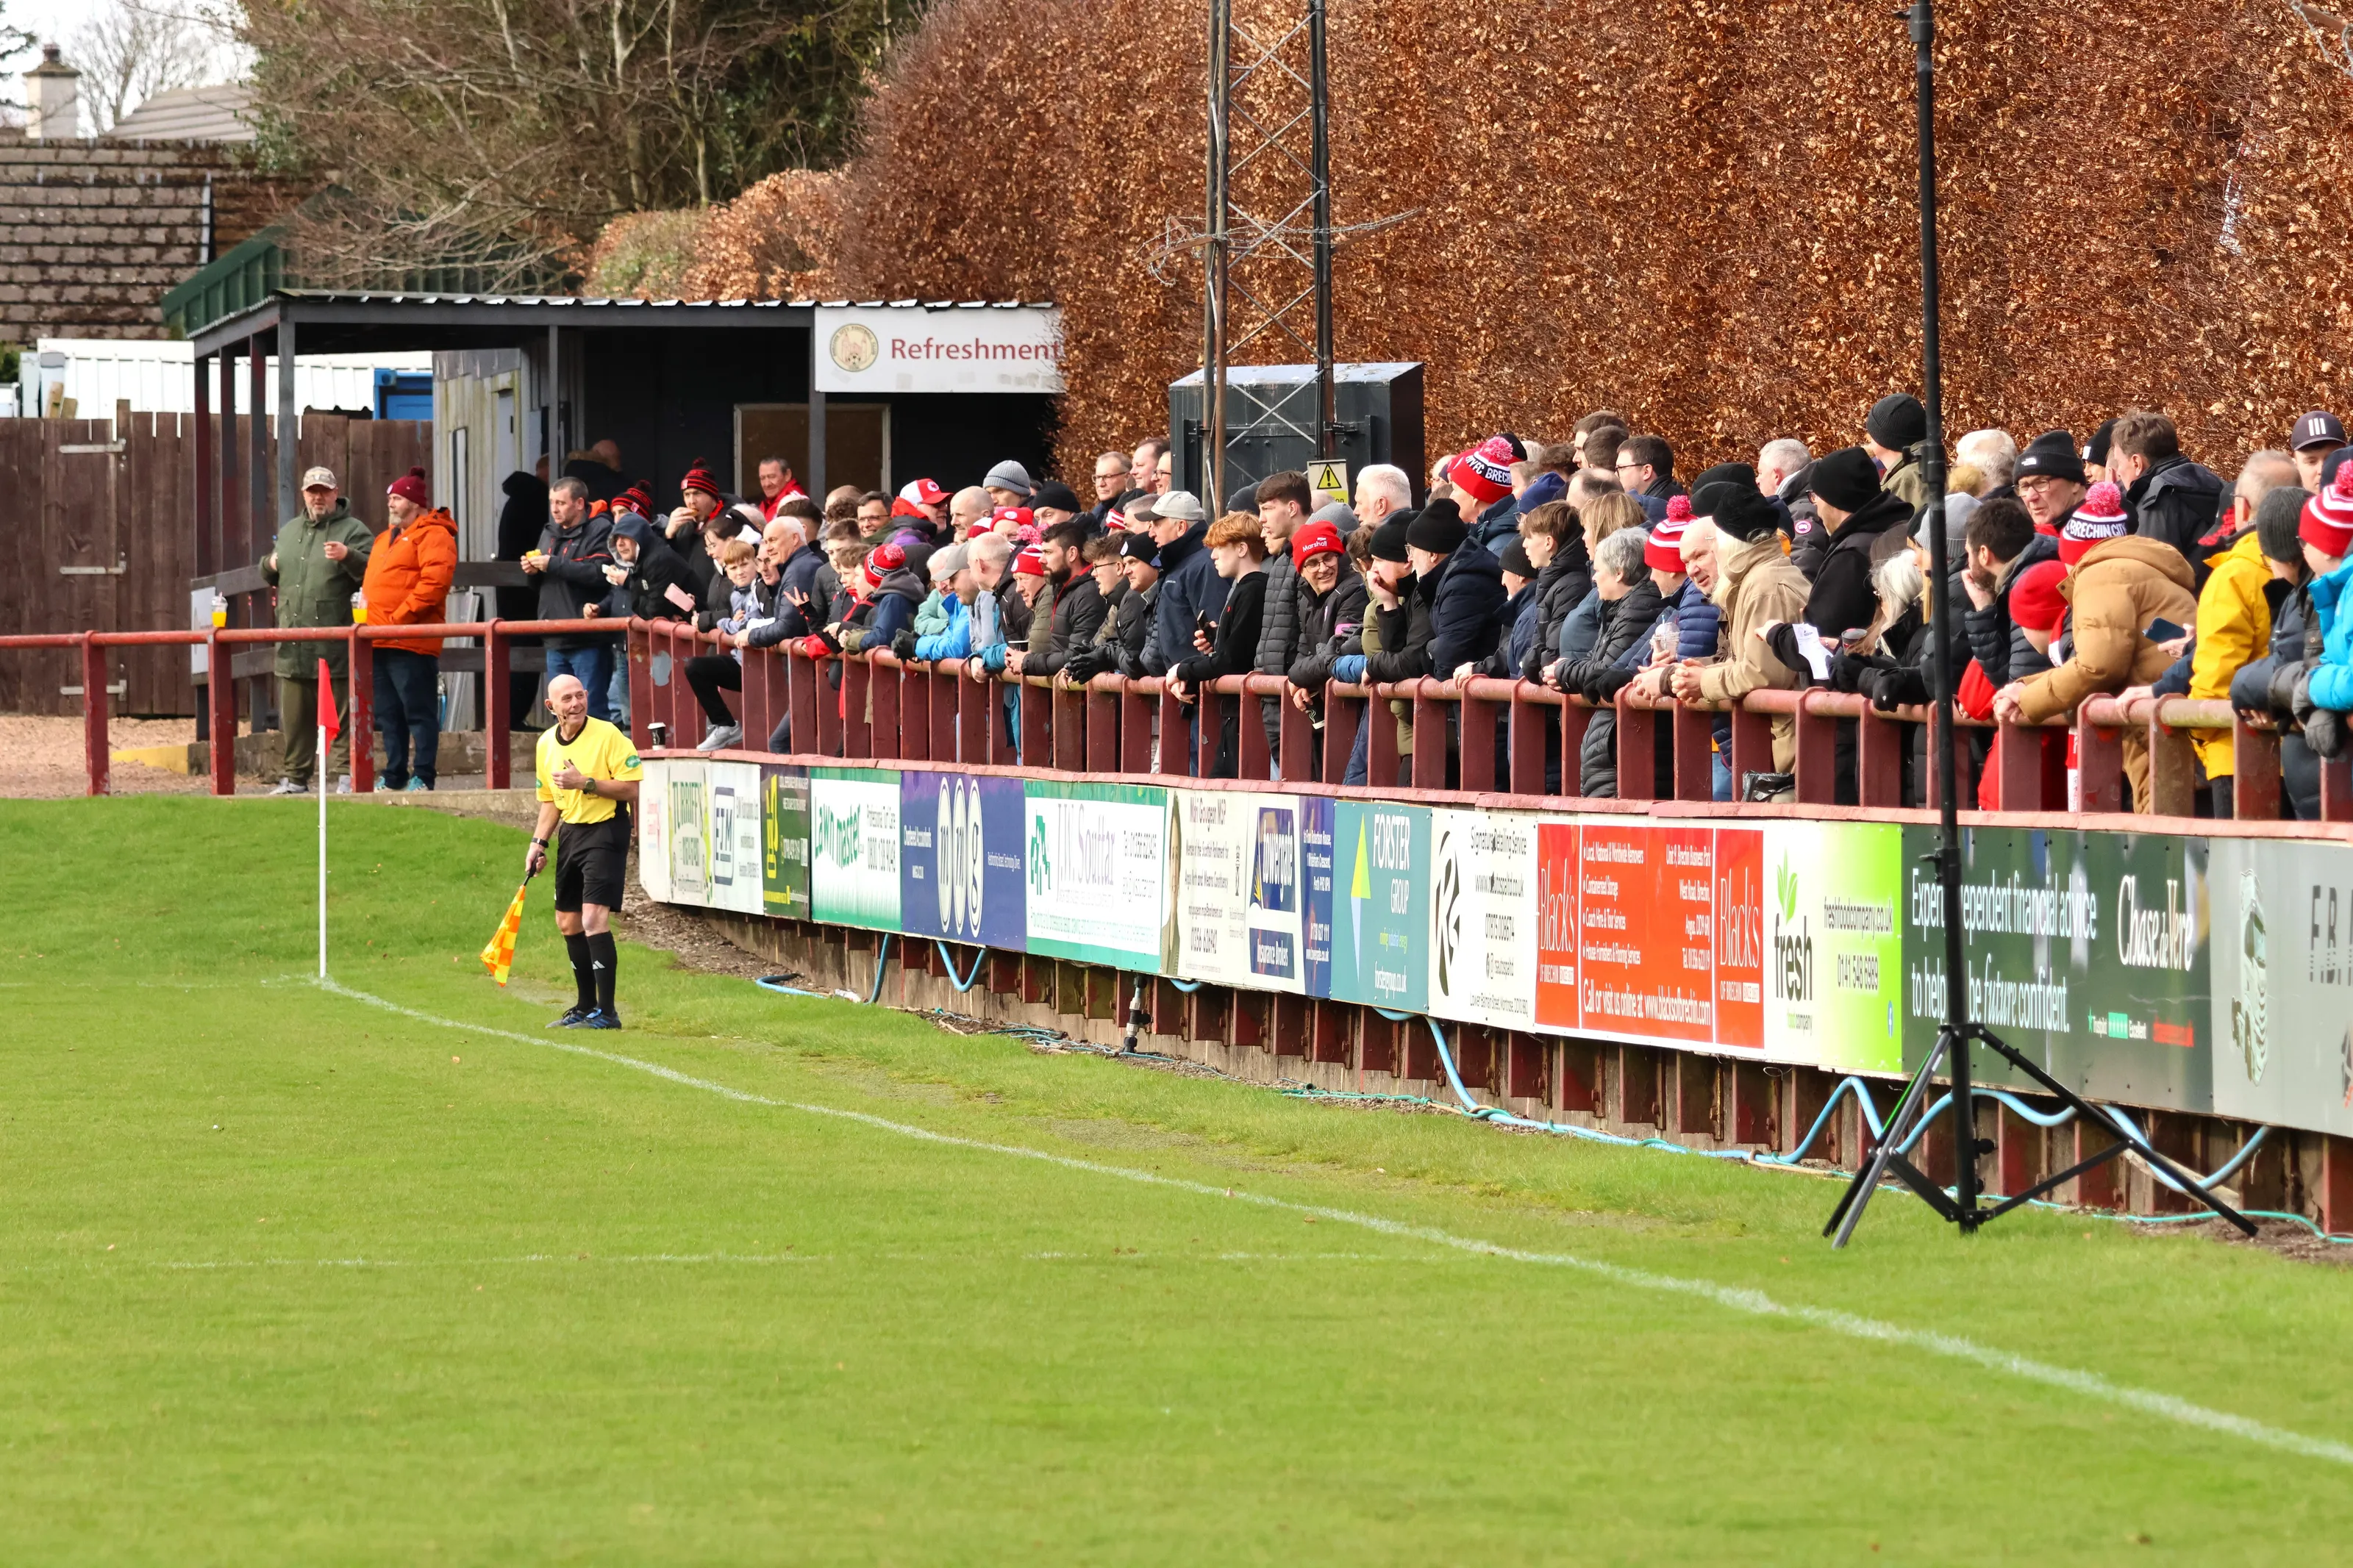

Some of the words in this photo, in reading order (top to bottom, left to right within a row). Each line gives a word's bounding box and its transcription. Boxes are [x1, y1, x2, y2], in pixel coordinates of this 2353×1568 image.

[1302, 541, 1328, 552] Marshall
[2069, 518, 2110, 539] BRECHIN
[815, 796, 834, 862] Lawn
[836, 803, 861, 870] master
[1217, 798, 1227, 825] MSP
[1263, 819, 1293, 902] towergate
[1373, 814, 1410, 871] FORSTER
[1678, 844, 1690, 866] Brechin
[1390, 878, 1409, 914] GROUP
[1540, 858, 1575, 953] Black's
[1679, 878, 1688, 901] West
[1960, 869, 2011, 946] ependent
[2013, 869, 2057, 937] financial
[2060, 873, 2097, 940] advice
[1585, 907, 1596, 928] Coach
[1614, 909, 1627, 931] Services
[1720, 867, 1760, 968] Black's
[1824, 896, 1893, 941] freshfoodcompany.co.uk
[2118, 875, 2160, 967] Chase
[2160, 912, 2168, 968] de
[2167, 879, 2193, 972] Vere
[1257, 938, 1276, 965] Insurance
[1276, 941, 1289, 967] Brokers
[1585, 940, 1596, 962] House
[1627, 943, 1641, 965] Services
[1774, 913, 1813, 1001] fresh
[1838, 953, 1851, 988] 0141
[1852, 954, 1863, 989] 548
[1864, 956, 1879, 990] 6989
[1583, 978, 1594, 1013] Call
[1596, 989, 1602, 1014] or
[1602, 982, 1613, 1015] visit
[1614, 991, 1621, 1016] us
[1621, 982, 1636, 1018] online
[1644, 984, 1711, 1027] www.blacksofbrechin.com
[1912, 962, 1922, 1017] to
[1924, 956, 1946, 1025] help
[1969, 959, 1982, 1023] be
[1981, 952, 2017, 1050] future
[2018, 965, 2070, 1034] confident.
